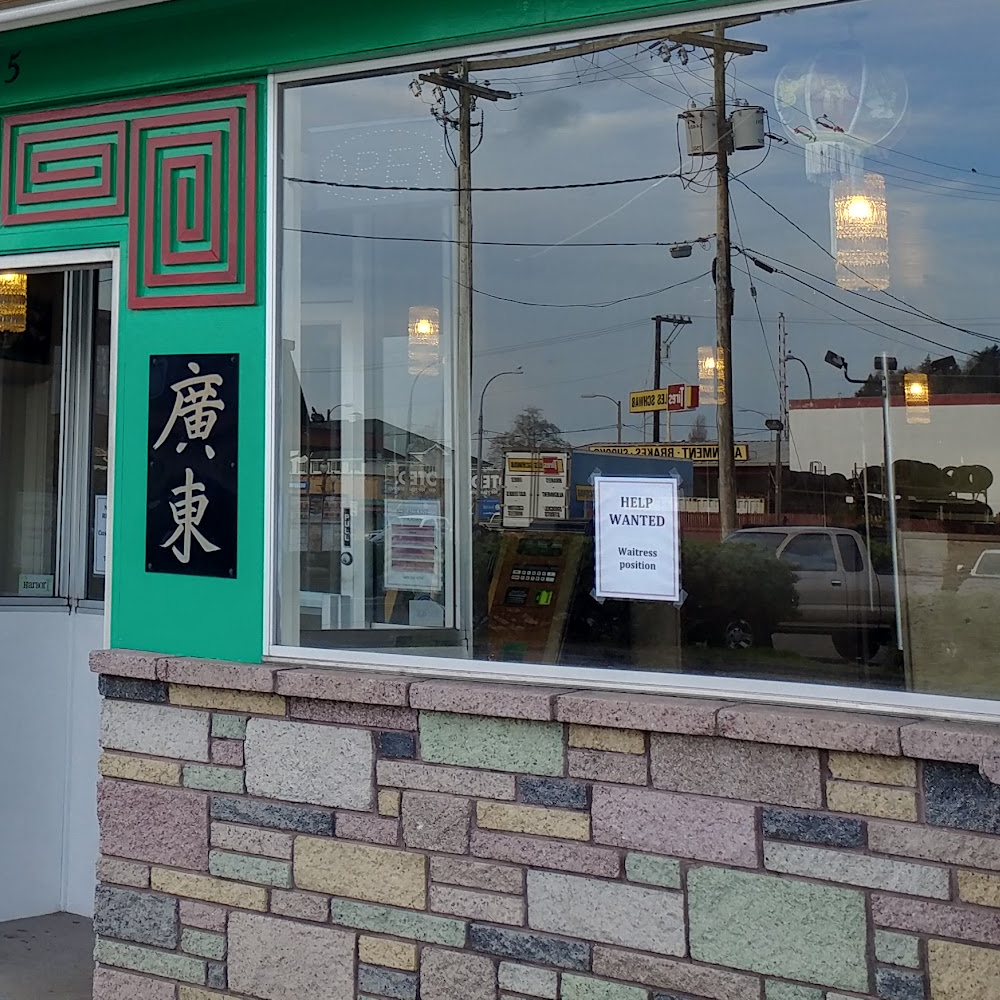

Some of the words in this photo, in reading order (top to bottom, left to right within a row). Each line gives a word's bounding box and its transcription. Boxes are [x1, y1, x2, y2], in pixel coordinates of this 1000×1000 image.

[153, 362, 225, 564] 廣東
[620, 496, 653, 509] HELP
[609, 513, 666, 527] WANTED
[618, 547, 658, 558] Waitress
[619, 561, 657, 571] position
